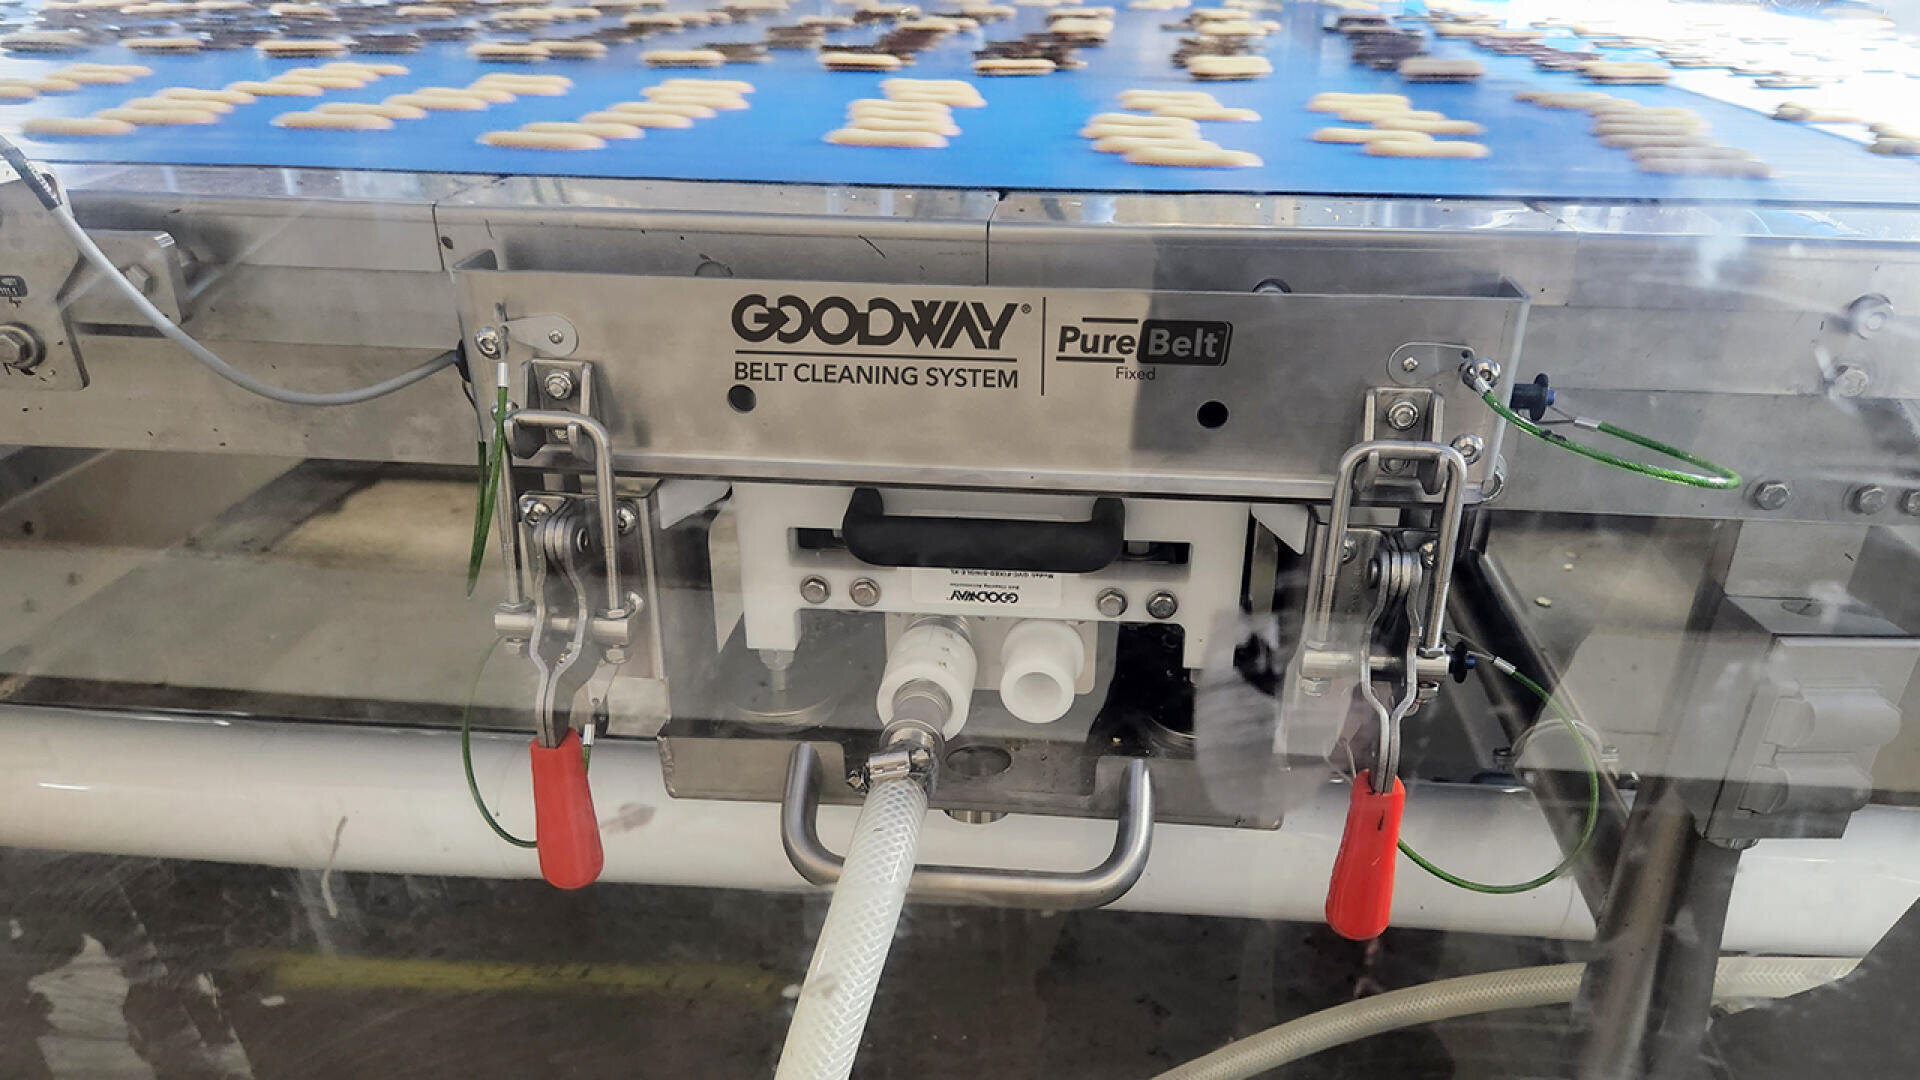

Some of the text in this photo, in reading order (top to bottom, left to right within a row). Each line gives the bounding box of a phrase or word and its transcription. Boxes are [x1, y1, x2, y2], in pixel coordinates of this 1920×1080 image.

[1058, 326, 1219, 358] Pure Belt
[734, 361, 1018, 389] BELT CLEANING SYSTEM
[1115, 366, 1156, 381] Fixed
